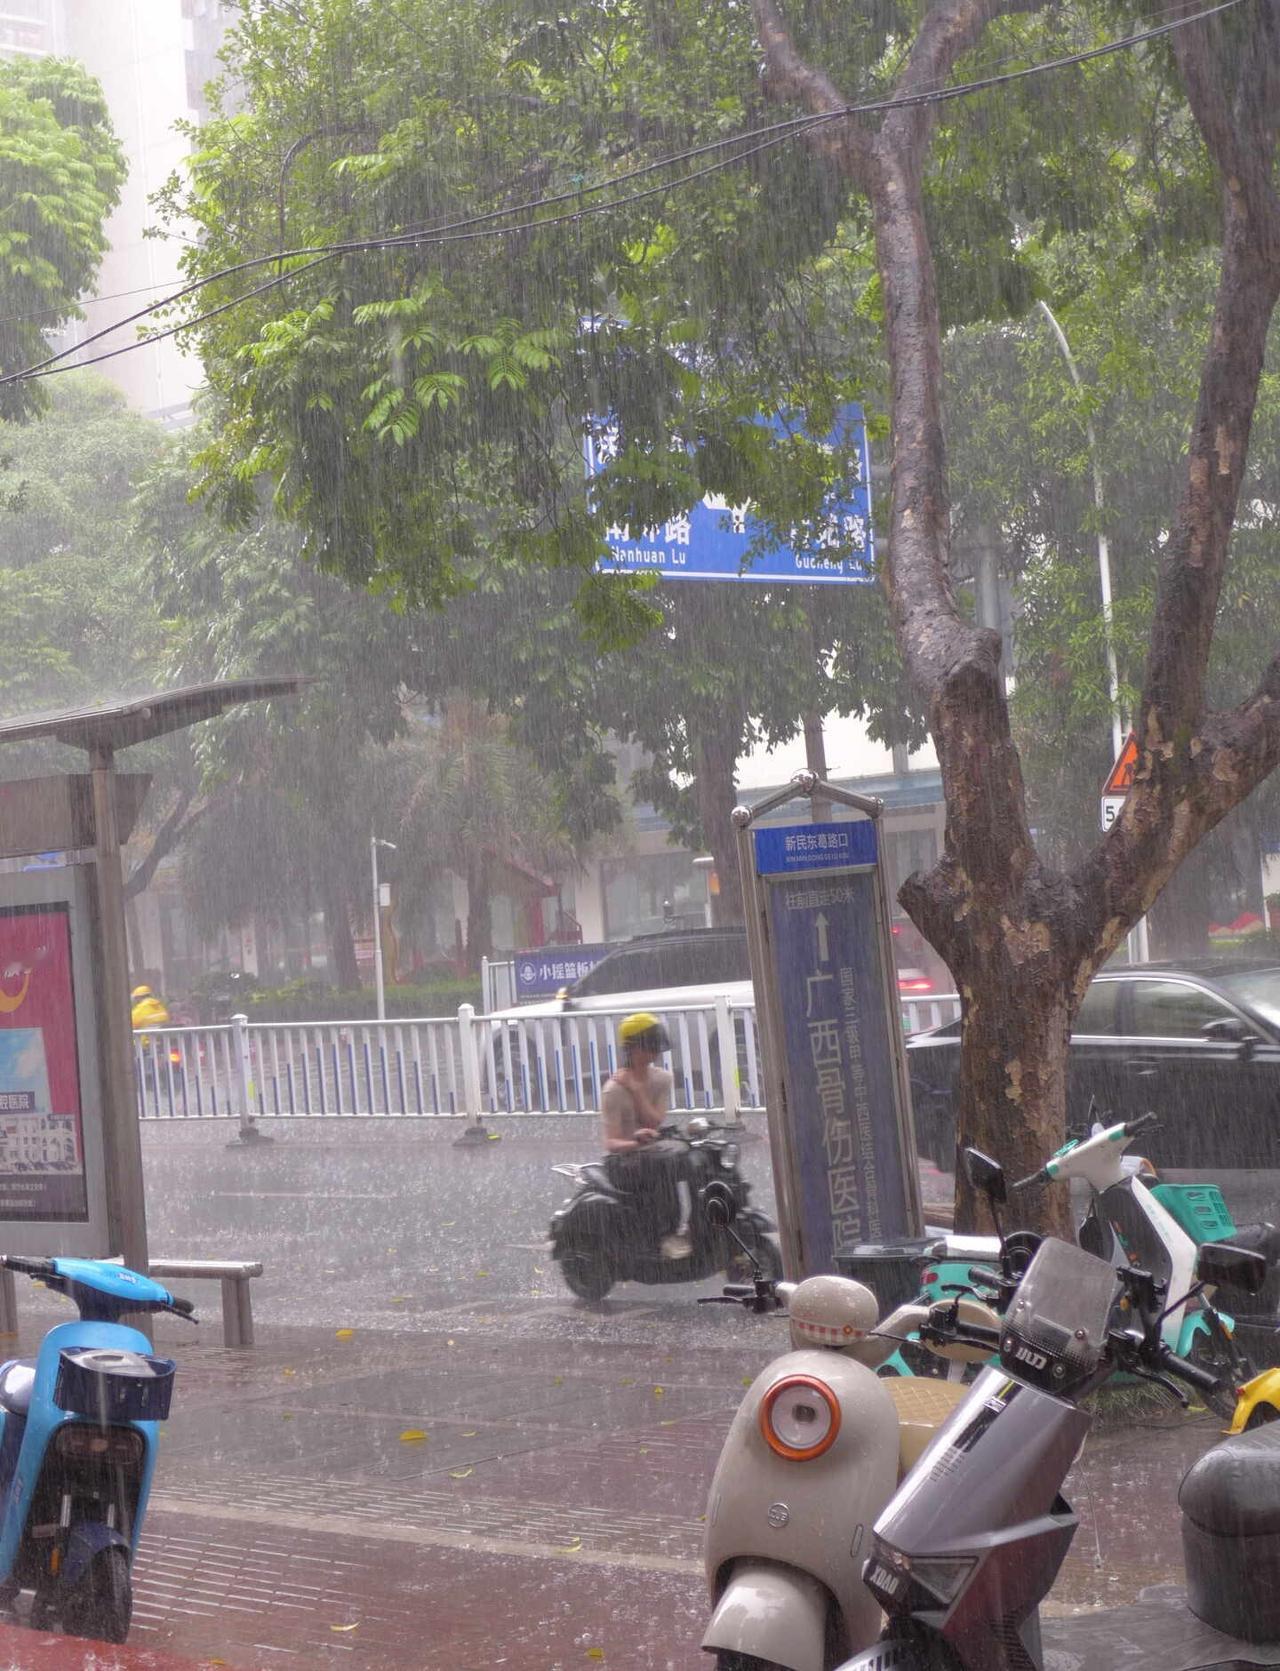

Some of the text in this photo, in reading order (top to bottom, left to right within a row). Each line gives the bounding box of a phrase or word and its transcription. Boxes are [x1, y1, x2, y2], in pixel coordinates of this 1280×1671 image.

[611, 545, 686, 564] Nanhuan Lu
[784, 833, 849, 852] 新民东葛路口
[539, 960, 601, 981] 小摇篮板
[804, 969, 863, 1256] 广西骨伤医院
[870, 1564, 899, 1596] XDAO
